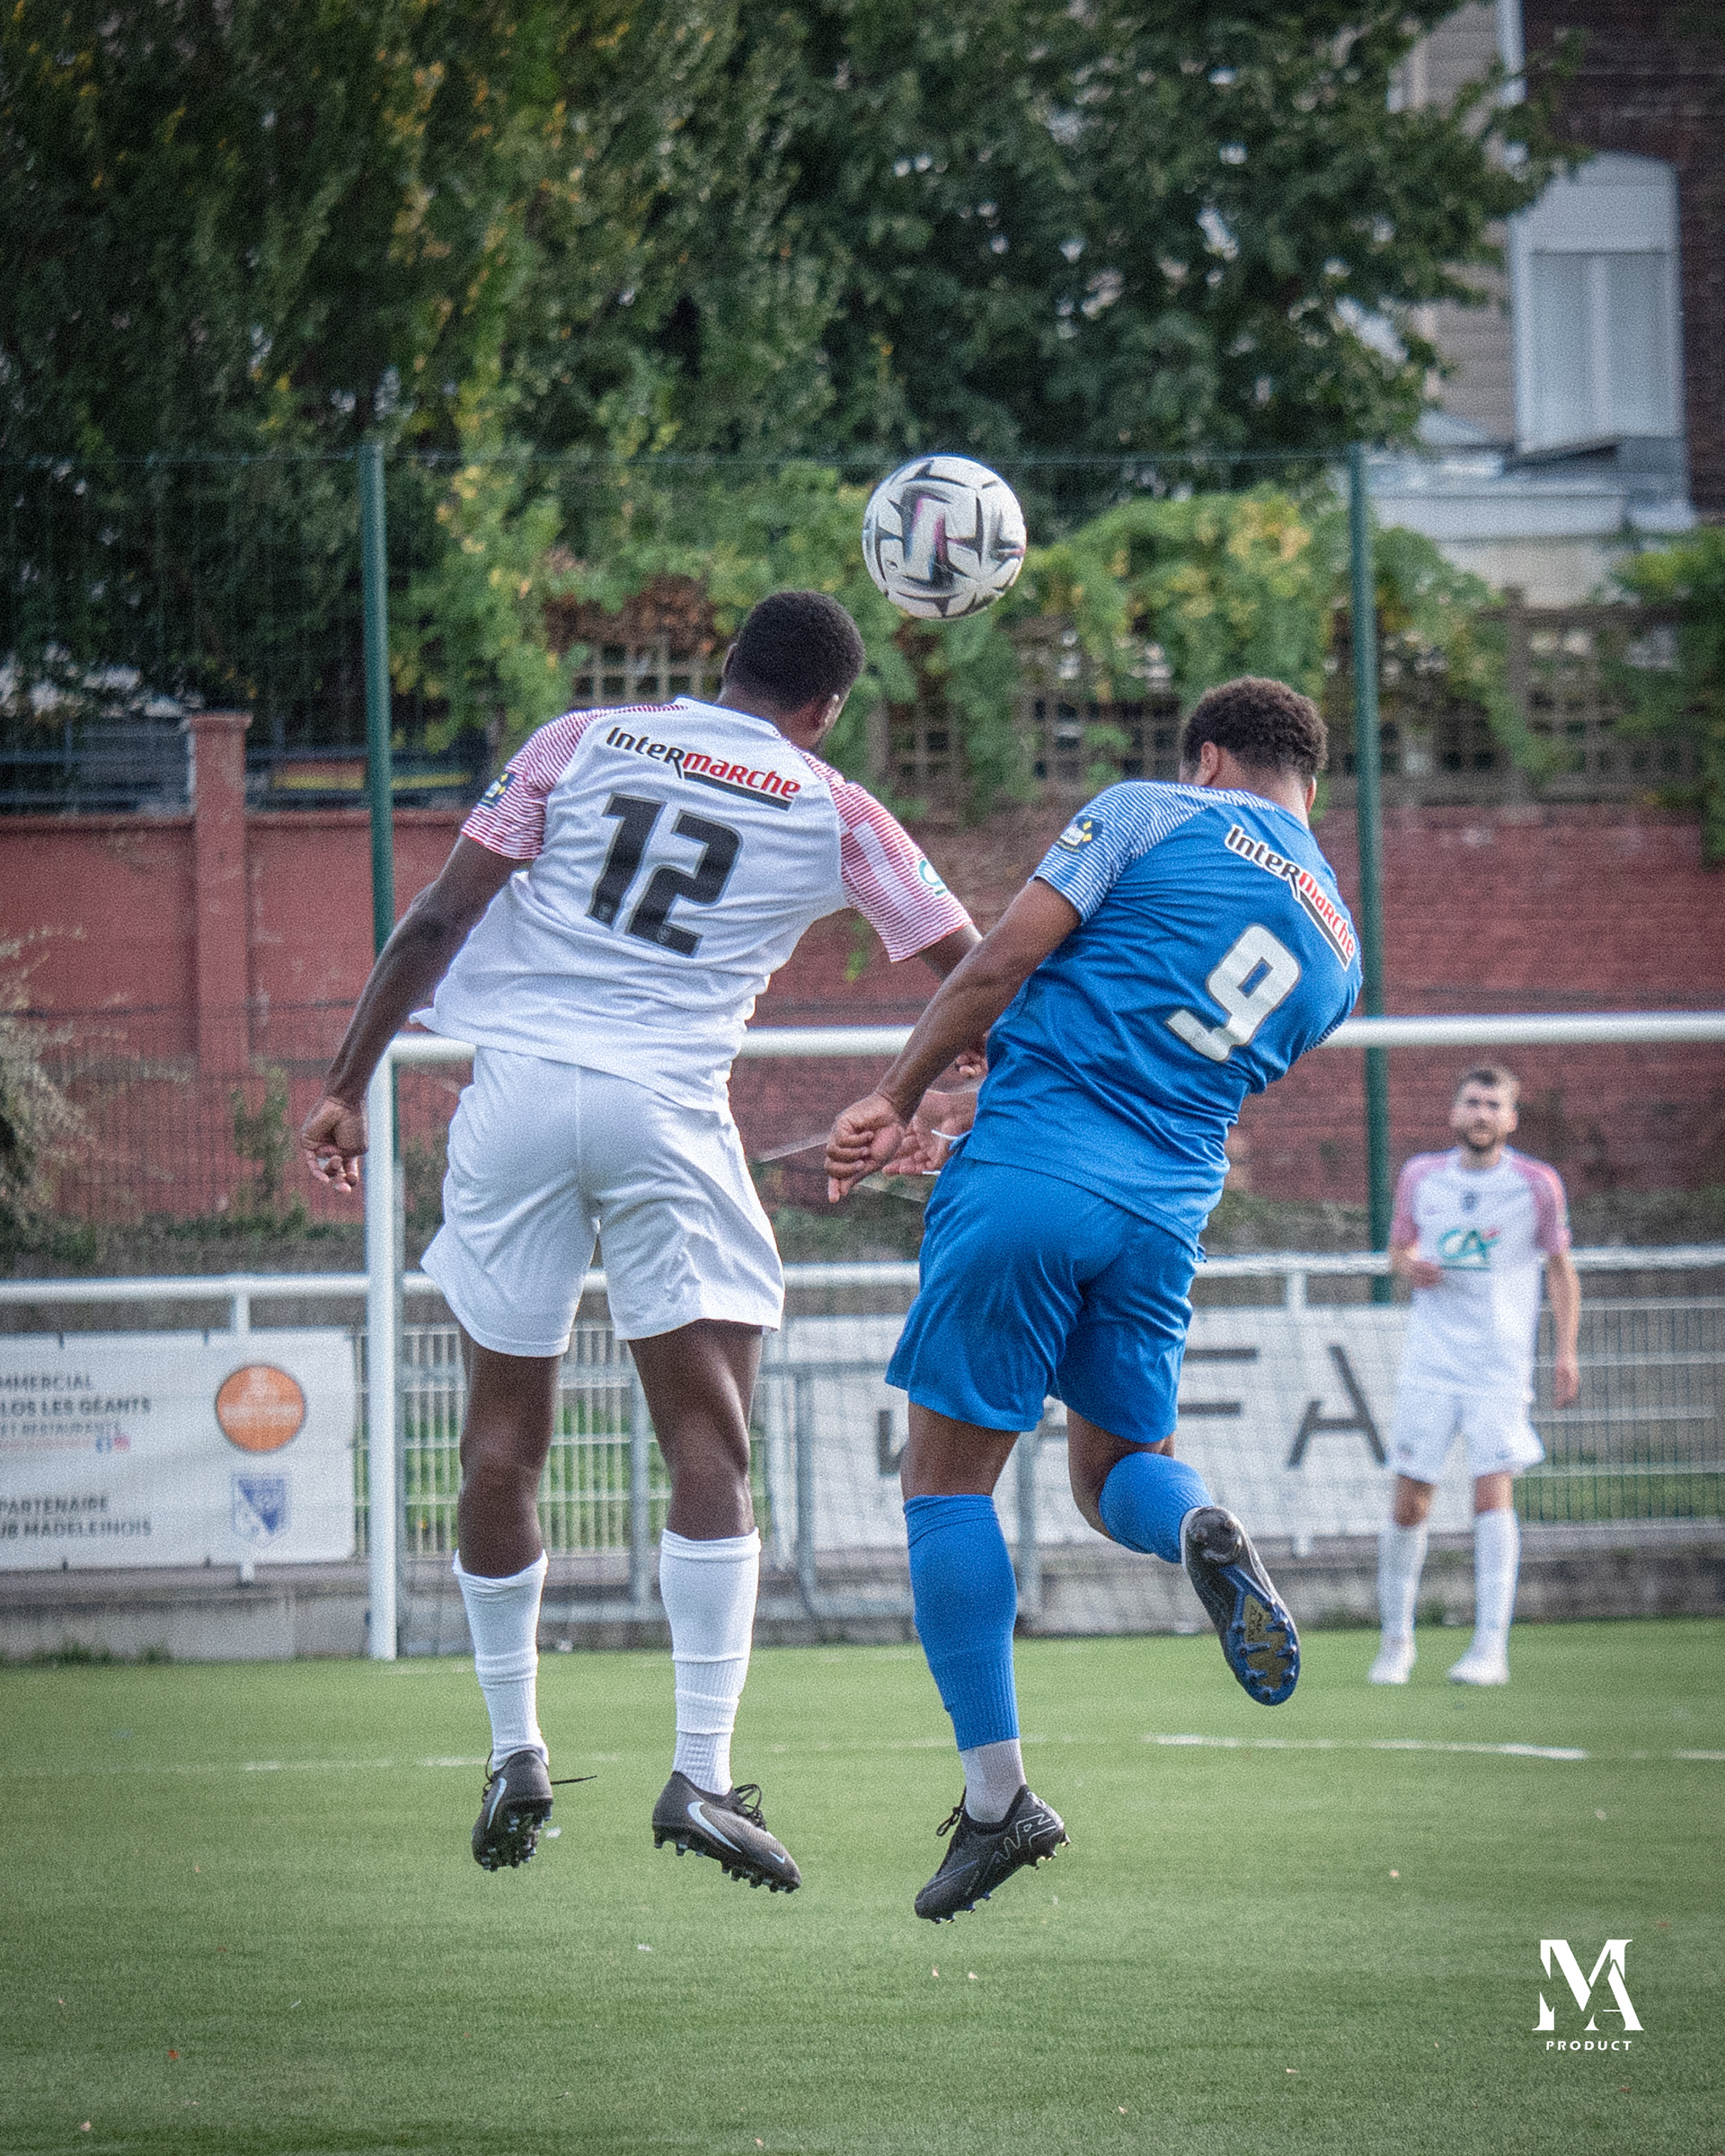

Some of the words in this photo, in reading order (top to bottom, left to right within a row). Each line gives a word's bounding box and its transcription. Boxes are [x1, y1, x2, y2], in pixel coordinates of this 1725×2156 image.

[586, 793, 744, 959] 12
[1165, 923, 1302, 1062] 9
[41, 1399, 74, 1416] LES
